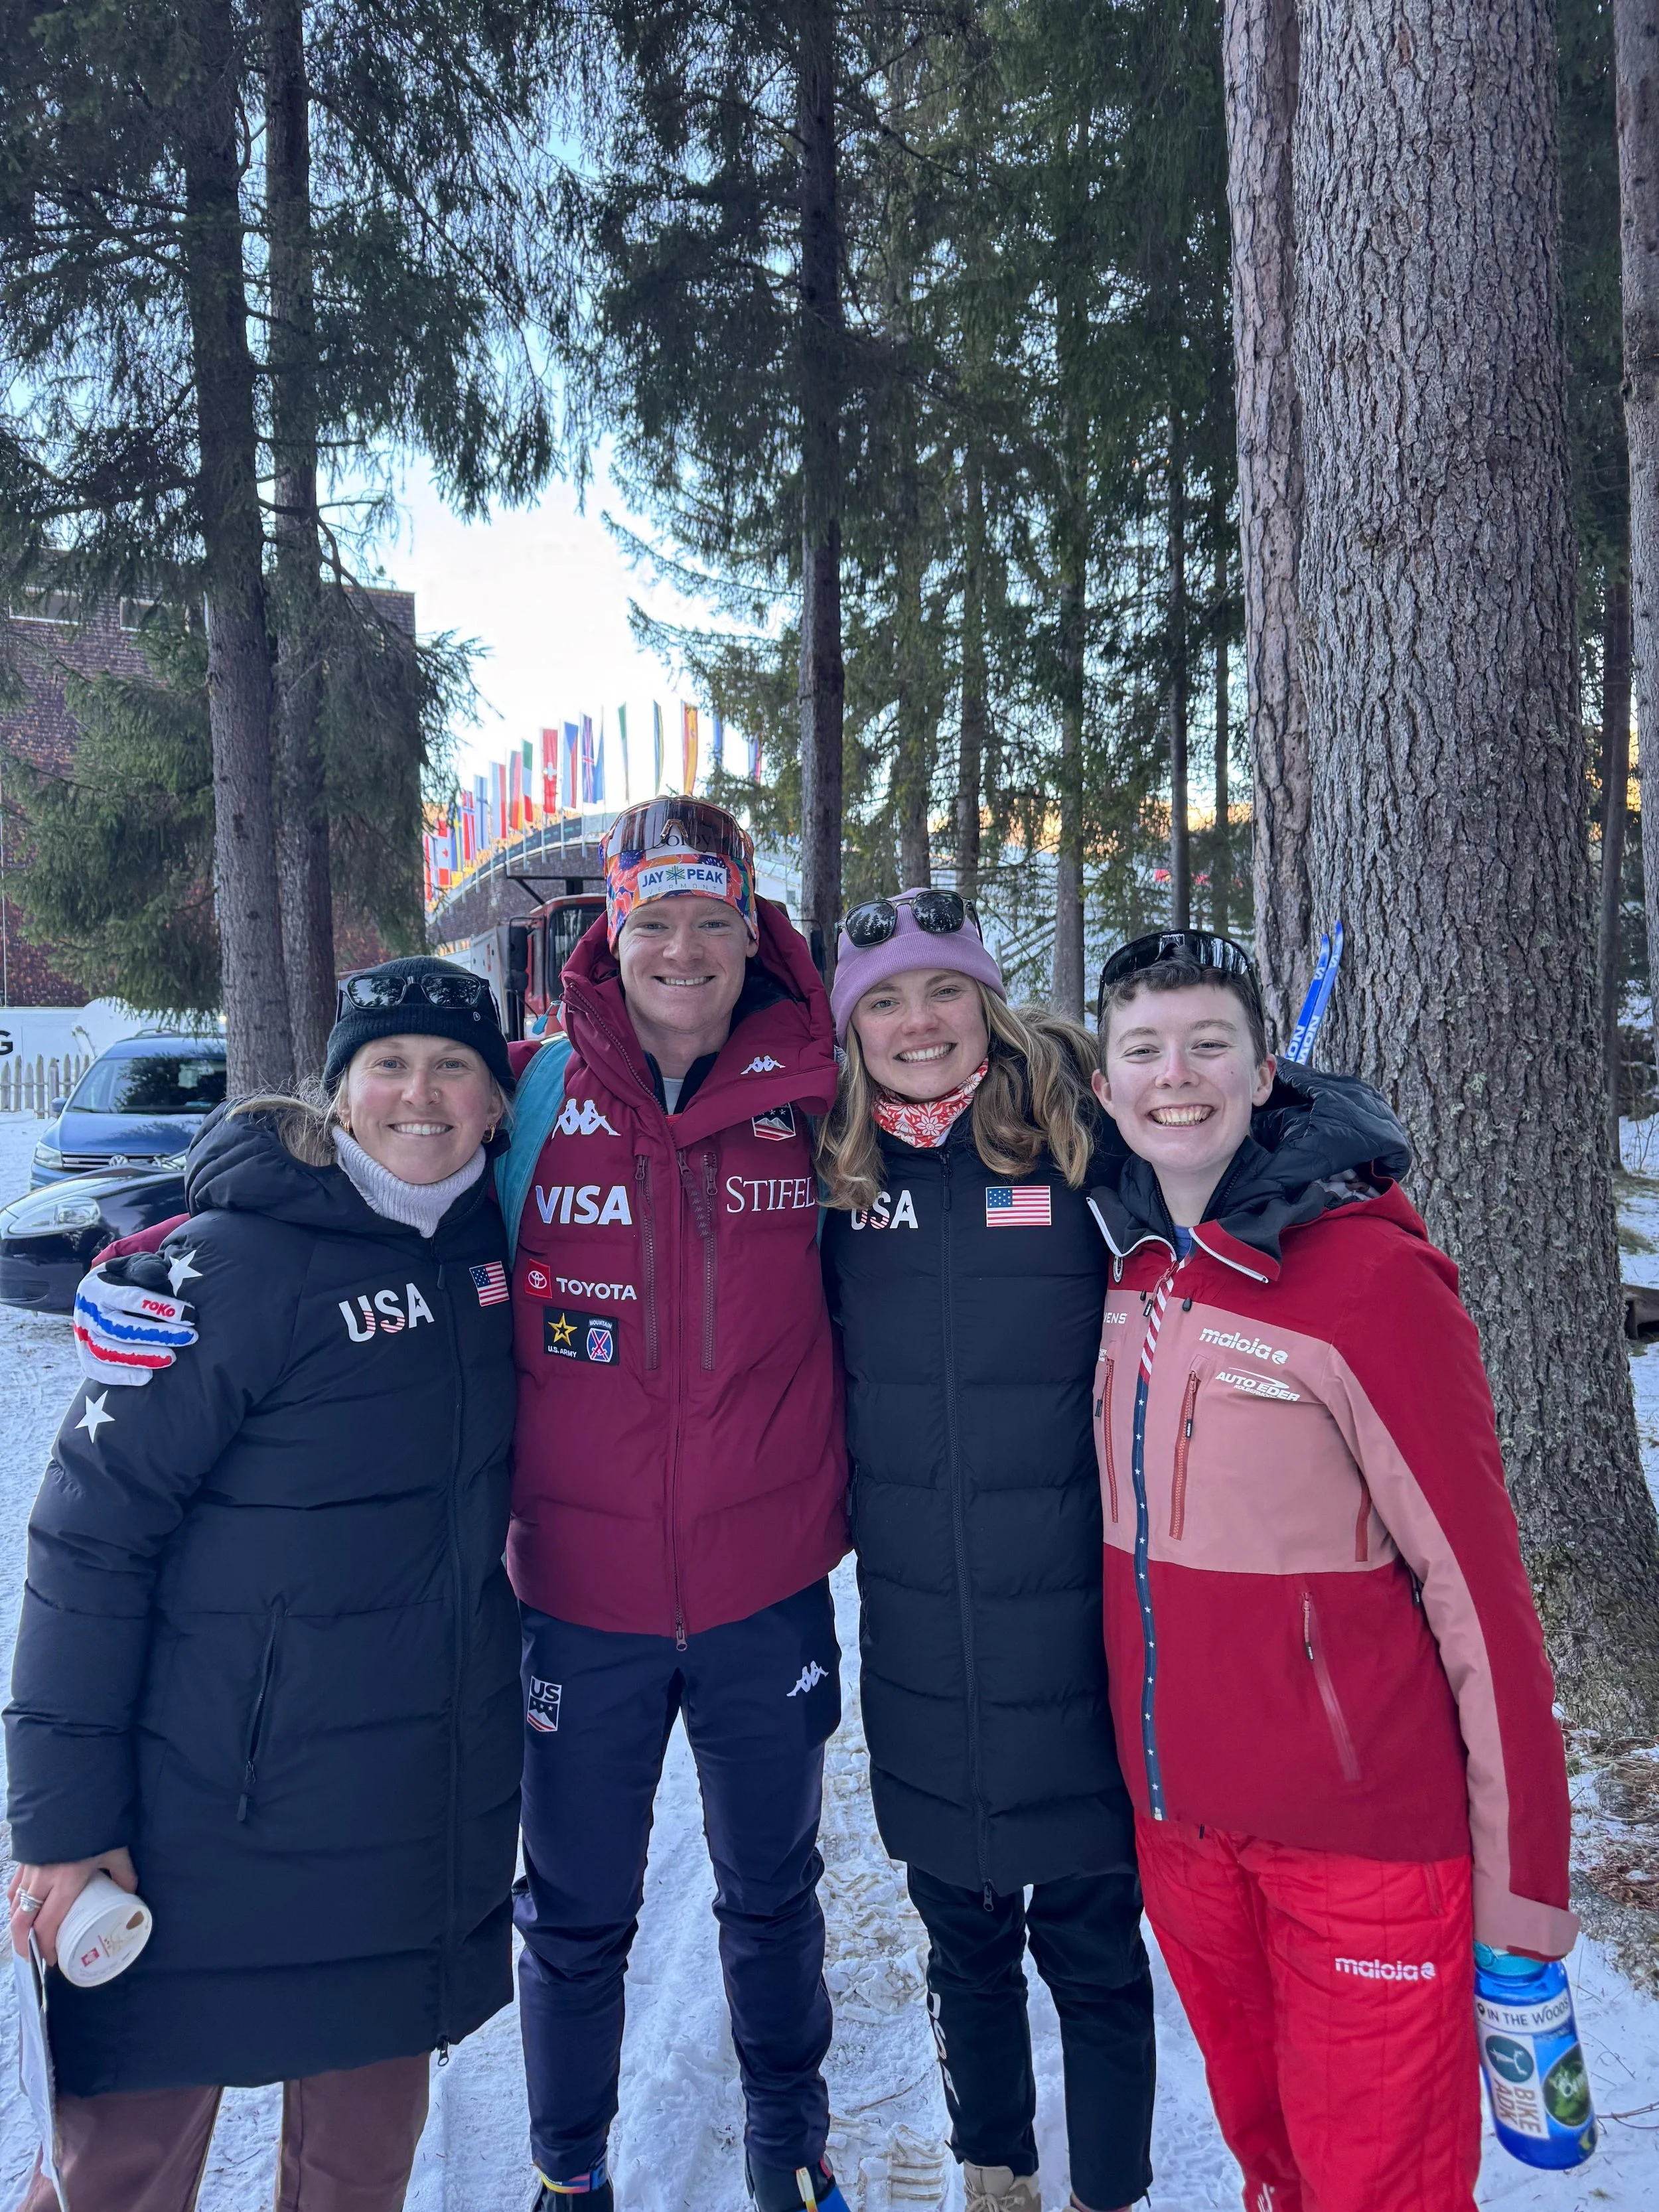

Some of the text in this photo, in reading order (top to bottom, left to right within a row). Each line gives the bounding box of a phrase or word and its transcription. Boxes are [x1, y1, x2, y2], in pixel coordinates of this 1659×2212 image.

[642, 868, 723, 888] JAY PEAK
[648, 883, 717, 895] VERMONT
[1285, 1025, 1305, 1062] ON
[535, 1185, 632, 1225] VISA
[726, 1175, 816, 1213] STIFEL
[851, 1189, 918, 1230] USA
[555, 1277, 637, 1300] TOYOTA
[141, 1299, 176, 1317] TOKO
[338, 1282, 435, 1343] USA
[589, 1319, 613, 1329] MOUNTAIN
[560, 1349, 577, 1358] ARMY
[1198, 1327, 1272, 1360] maloja
[1215, 1371, 1301, 1402] AUTO EDER
[1233, 1384, 1277, 1399] KOLBERMOO
[531, 1678, 560, 1702] US
[1334, 1957, 1418, 1981] maloja
[1487, 2008, 1500, 2023] IN
[1502, 2012, 1529, 2026] THE
[1494, 2077, 1519, 2126] ADK
[1514, 2085, 1542, 2134] BIKE
